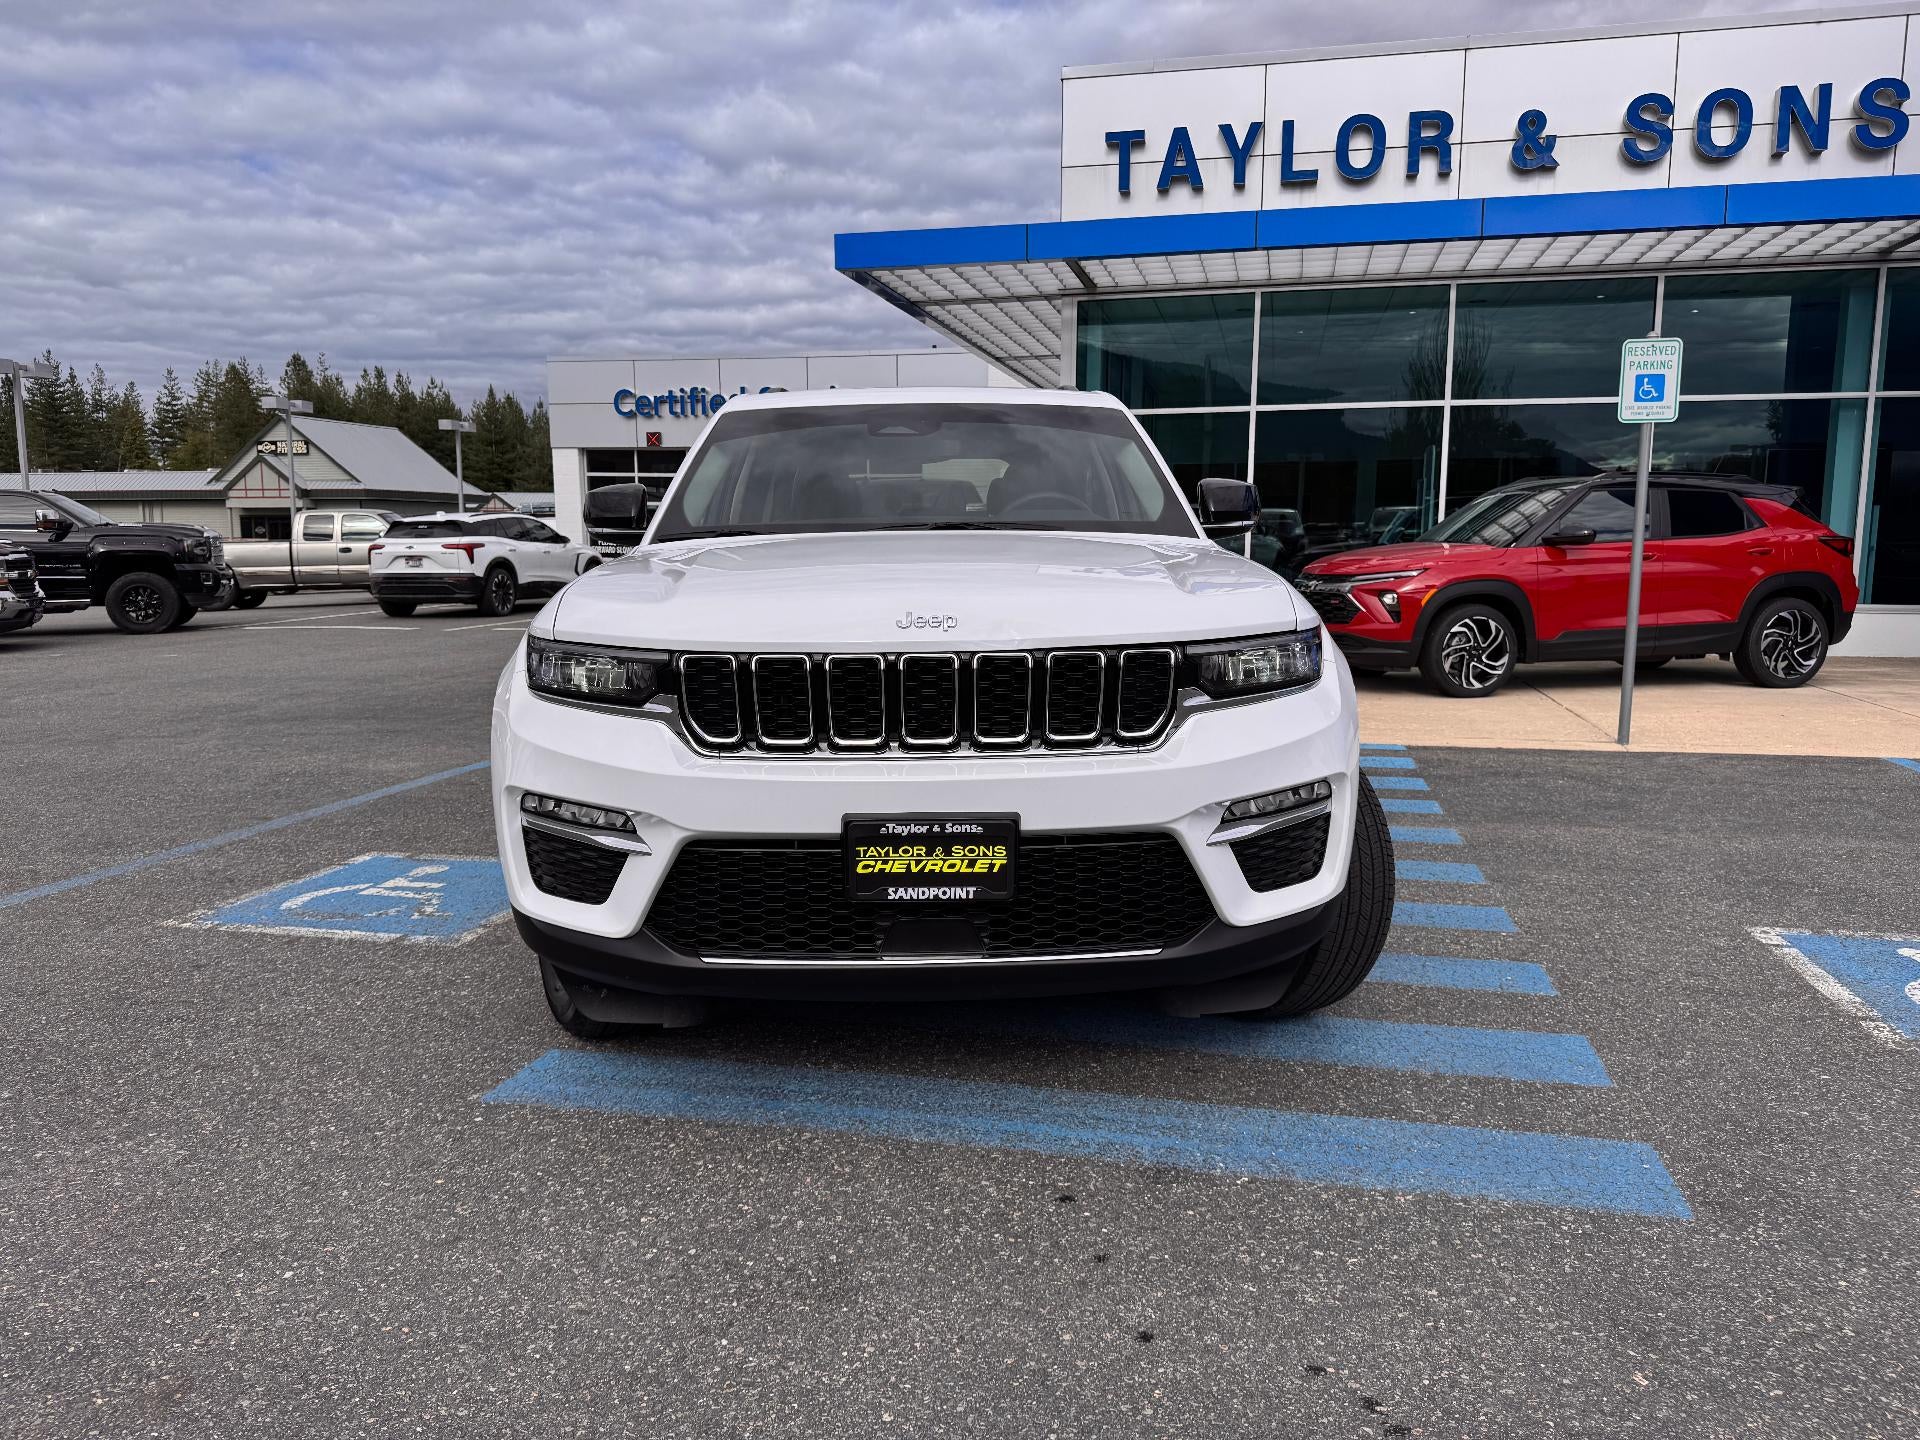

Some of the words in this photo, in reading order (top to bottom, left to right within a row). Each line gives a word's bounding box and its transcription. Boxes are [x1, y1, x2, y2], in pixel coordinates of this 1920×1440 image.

[1105, 111, 1454, 194] TAYLOR
[1511, 110, 1558, 170] &
[1622, 77, 1911, 166] SONS
[1627, 345, 1677, 357] RESERVED
[1629, 360, 1673, 370] PARKING
[896, 611, 958, 632] Jeep
[886, 823, 930, 836] Taylor
[944, 823, 977, 834] Sons
[855, 846, 926, 858] TAYLOR
[932, 847, 945, 859] &
[951, 845, 1007, 857] SONS
[856, 859, 1008, 873] CHEVROLET
[887, 887, 976, 900] SANDPOINT
